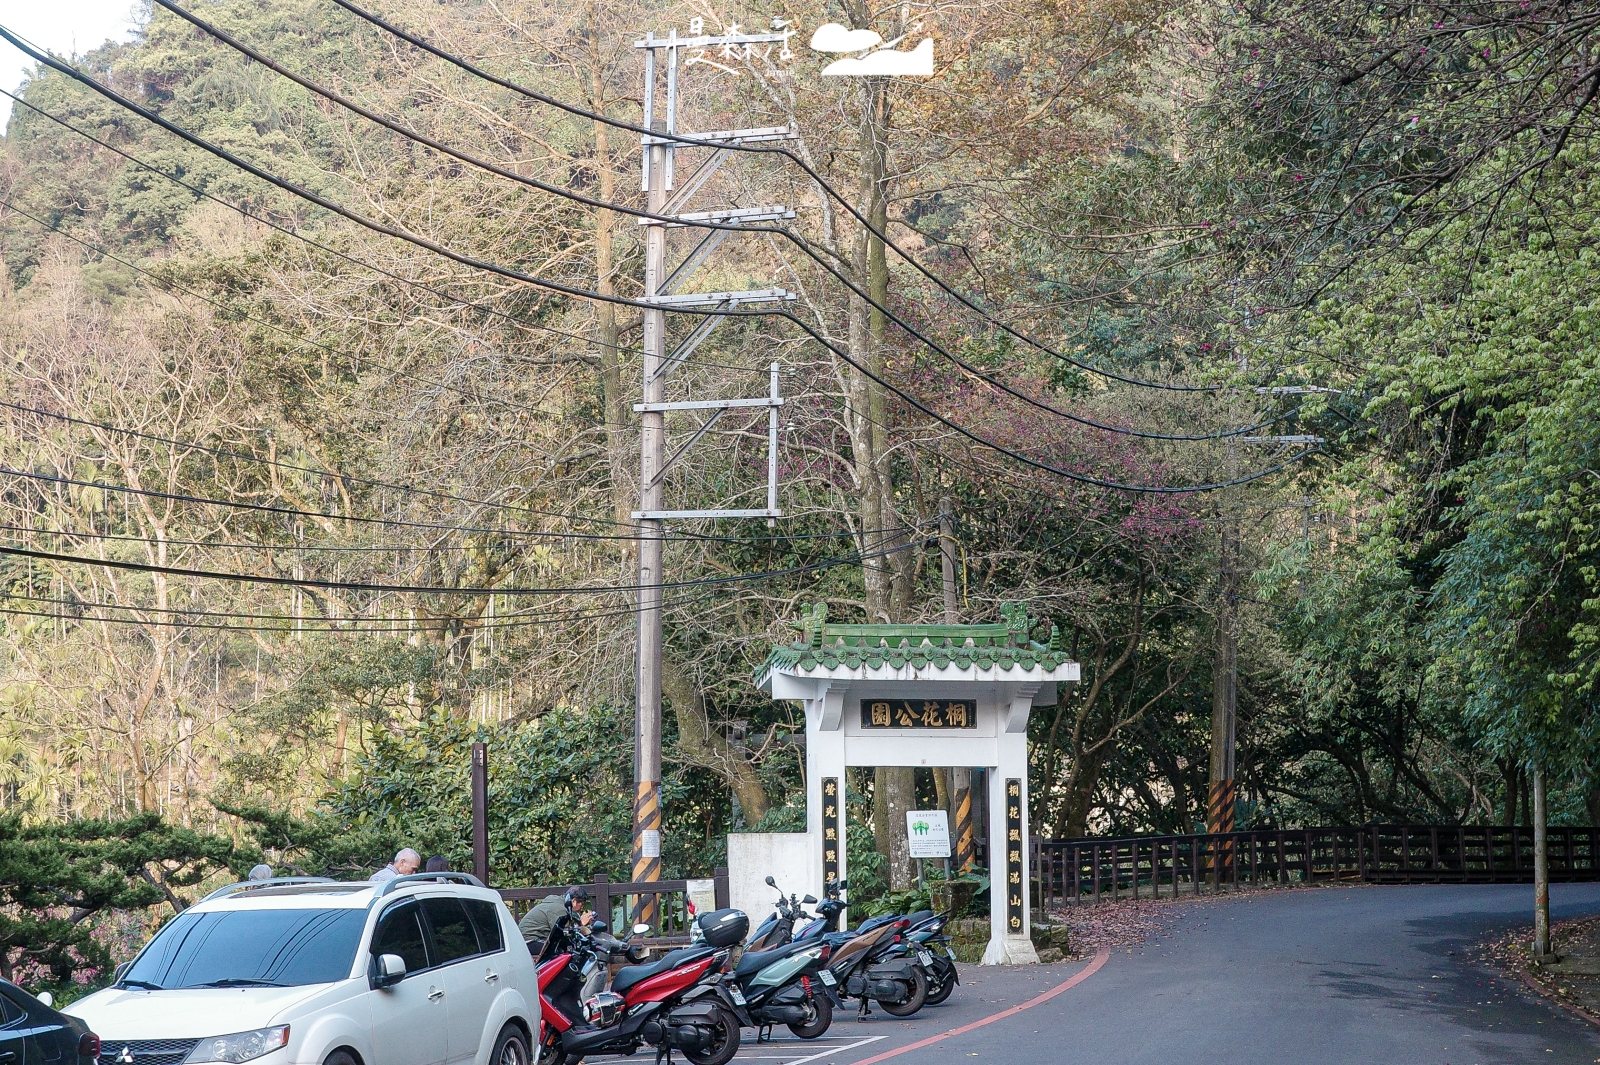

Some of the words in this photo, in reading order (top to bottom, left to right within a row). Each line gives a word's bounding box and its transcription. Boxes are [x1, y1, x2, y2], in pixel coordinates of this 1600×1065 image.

[871, 701, 967, 727] 桐花公園
[825, 783, 837, 899] 螢光點點星
[1008, 784, 1021, 928] 桐花飄飄滿山白
